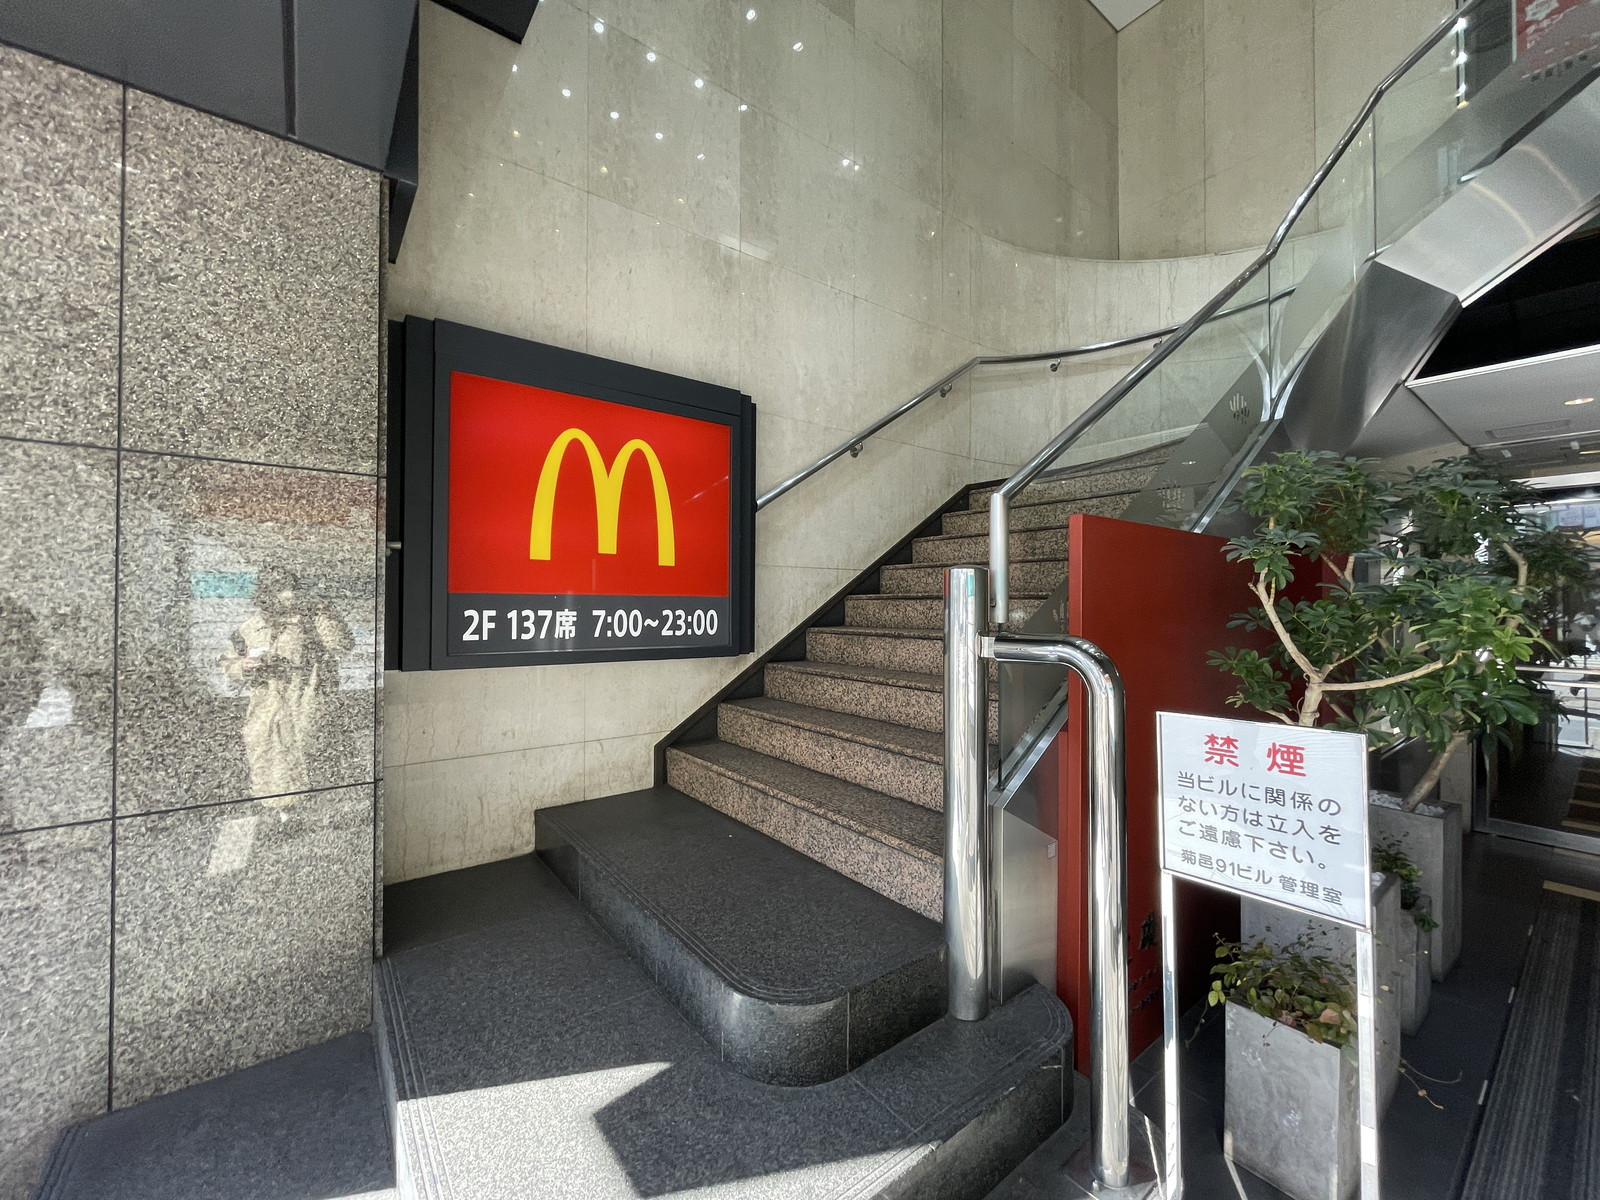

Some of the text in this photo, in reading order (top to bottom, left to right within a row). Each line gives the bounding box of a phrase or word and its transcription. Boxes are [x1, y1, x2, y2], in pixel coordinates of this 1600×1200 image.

[462, 609, 497, 641] 2F
[506, 608, 578, 641] 137席
[1177, 770, 1342, 816] 当ビルに関係の
[1178, 795, 1342, 845] ない方は立入を
[1178, 819, 1328, 870] ご遠慮下さい。
[1278, 874, 1343, 907] 管理室
